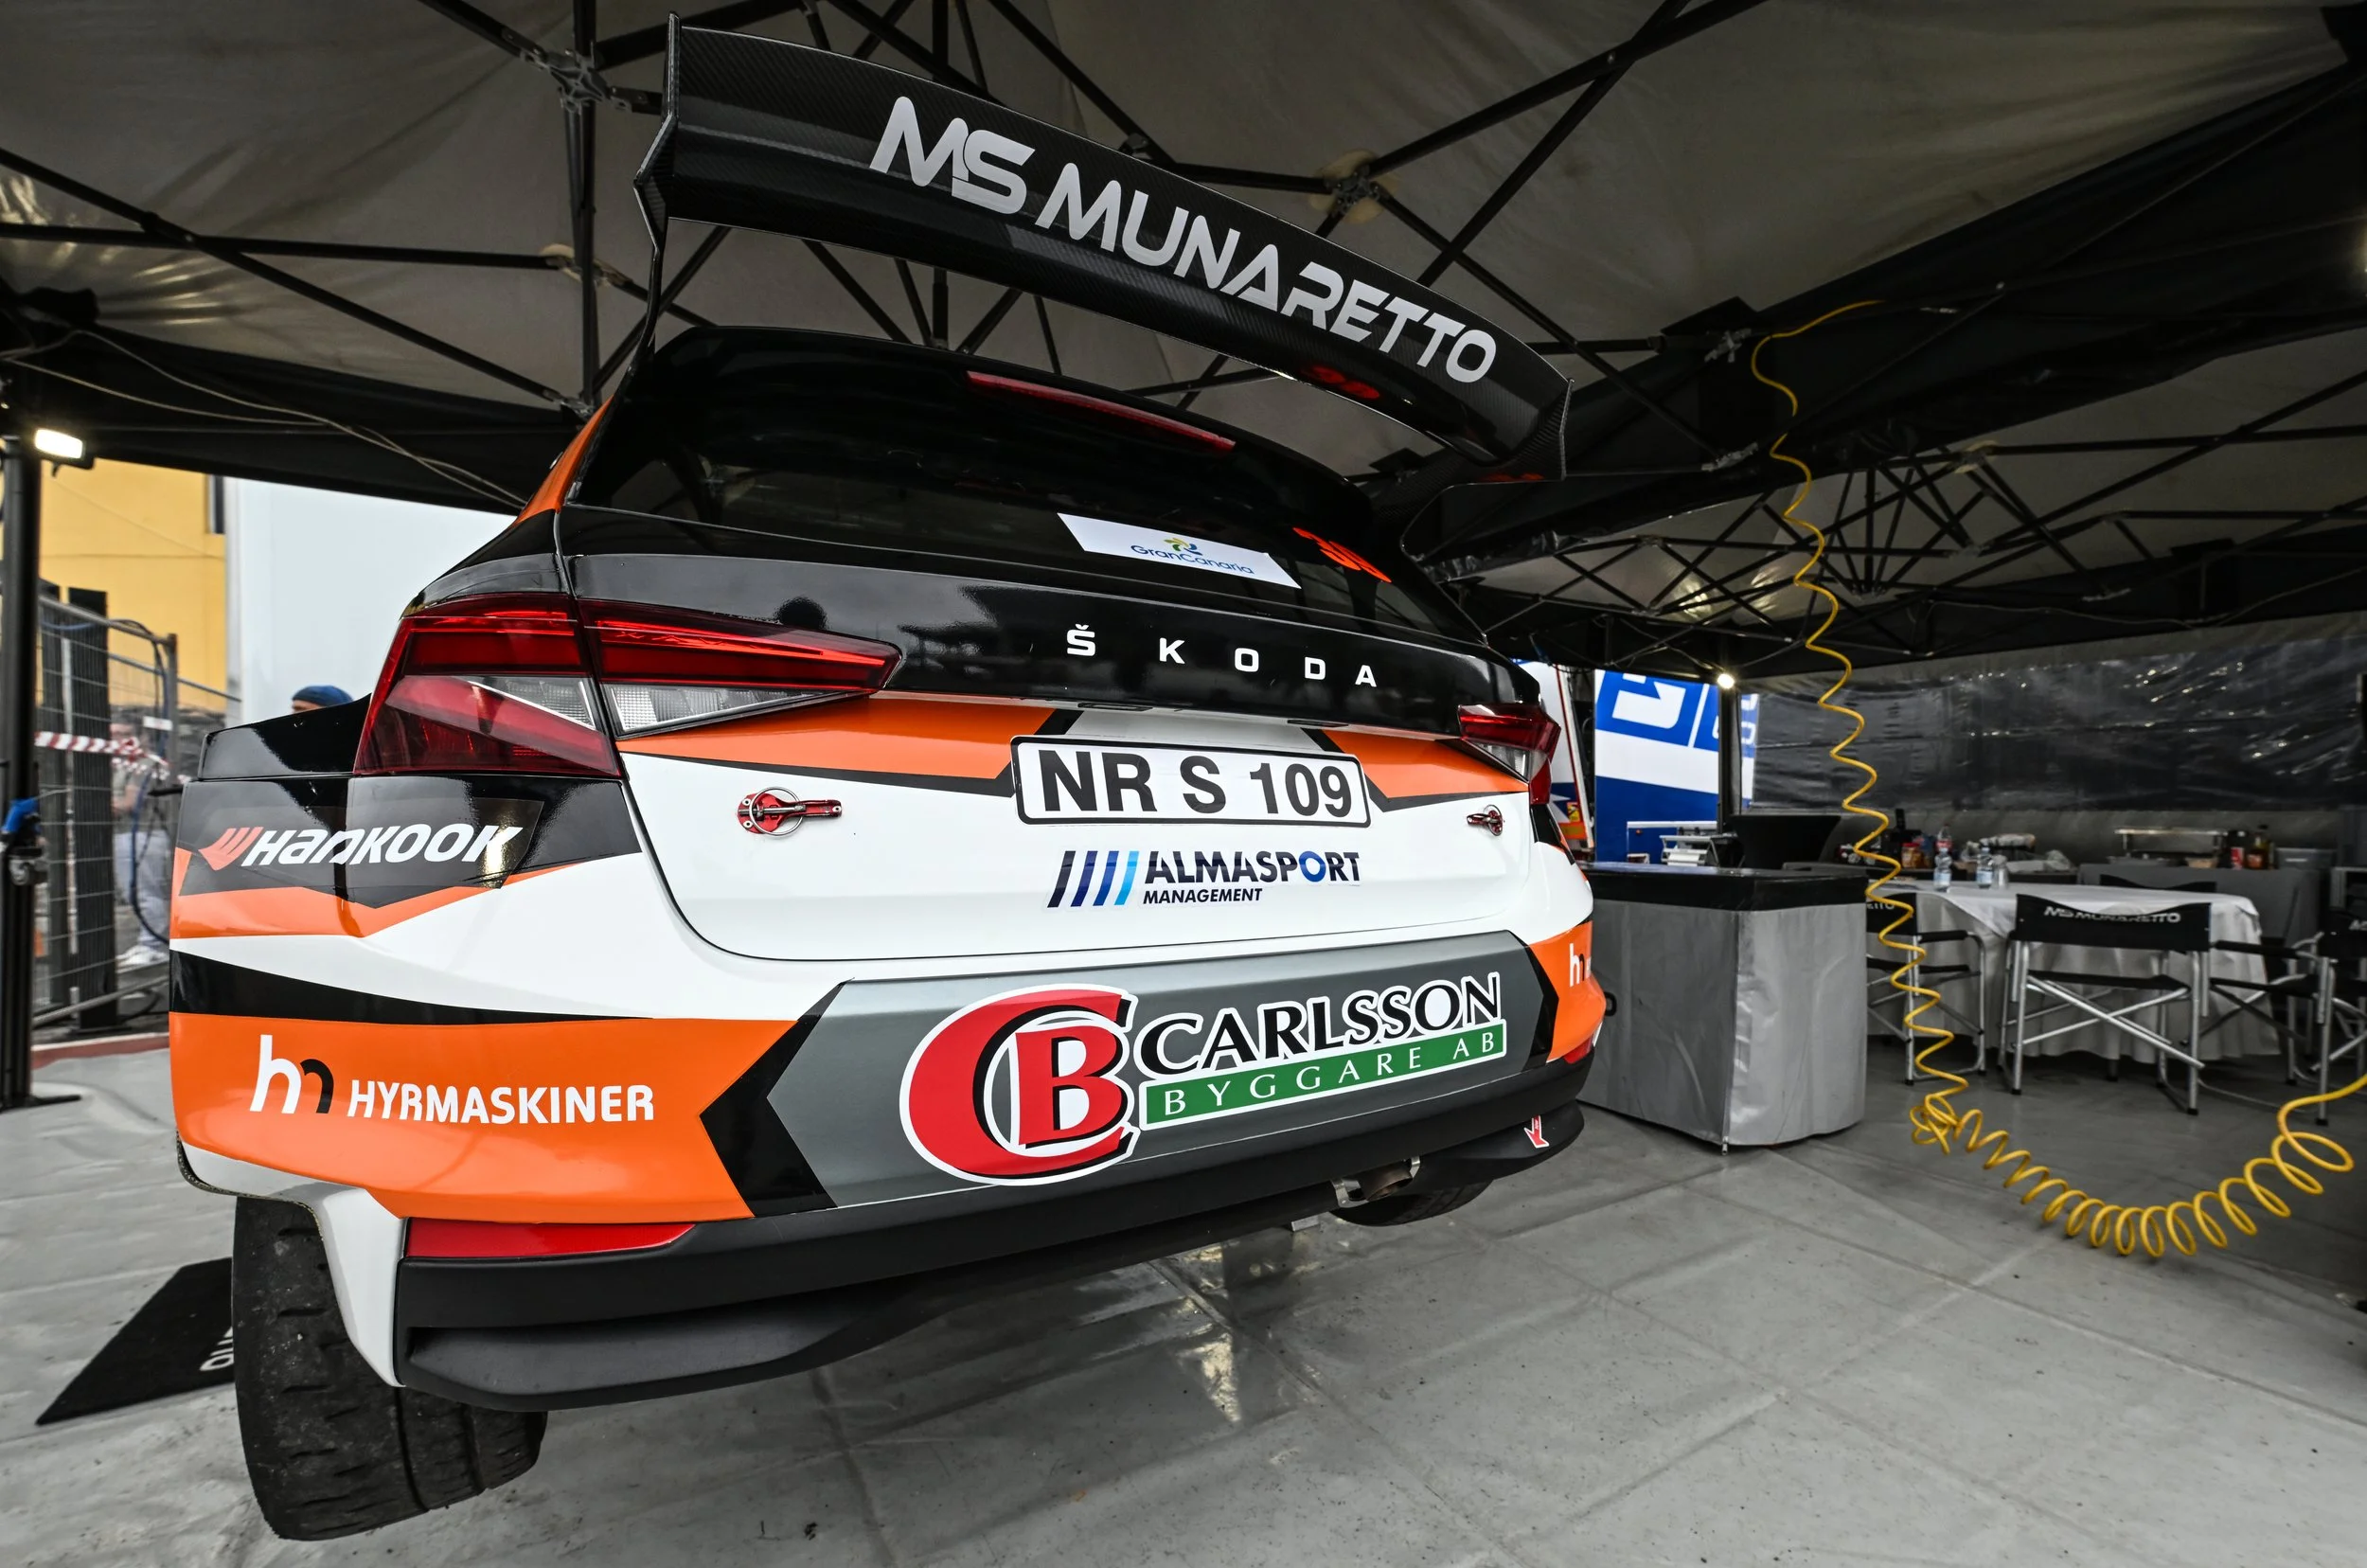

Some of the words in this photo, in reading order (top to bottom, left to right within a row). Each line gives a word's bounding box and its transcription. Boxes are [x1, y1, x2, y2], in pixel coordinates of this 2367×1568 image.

[870, 97, 1035, 214] MS
[1036, 163, 1497, 383] MUNARETTO
[1130, 544, 1255, 575] GranCanaria
[1067, 623, 1377, 687] ŠKODA
[1039, 750, 1158, 812] NR
[1180, 756, 1226, 814] S
[1250, 763, 1352, 818] 109
[1143, 888, 1262, 904] MANAGEMENT
[1145, 850, 1360, 883] ALMASPORT
[1140, 975, 1499, 1075] CARLSSON
[347, 1079, 654, 1124] HYRMASKINER
[1165, 1046, 1421, 1115] BYGGARE
[1452, 1032, 1495, 1060] AB
